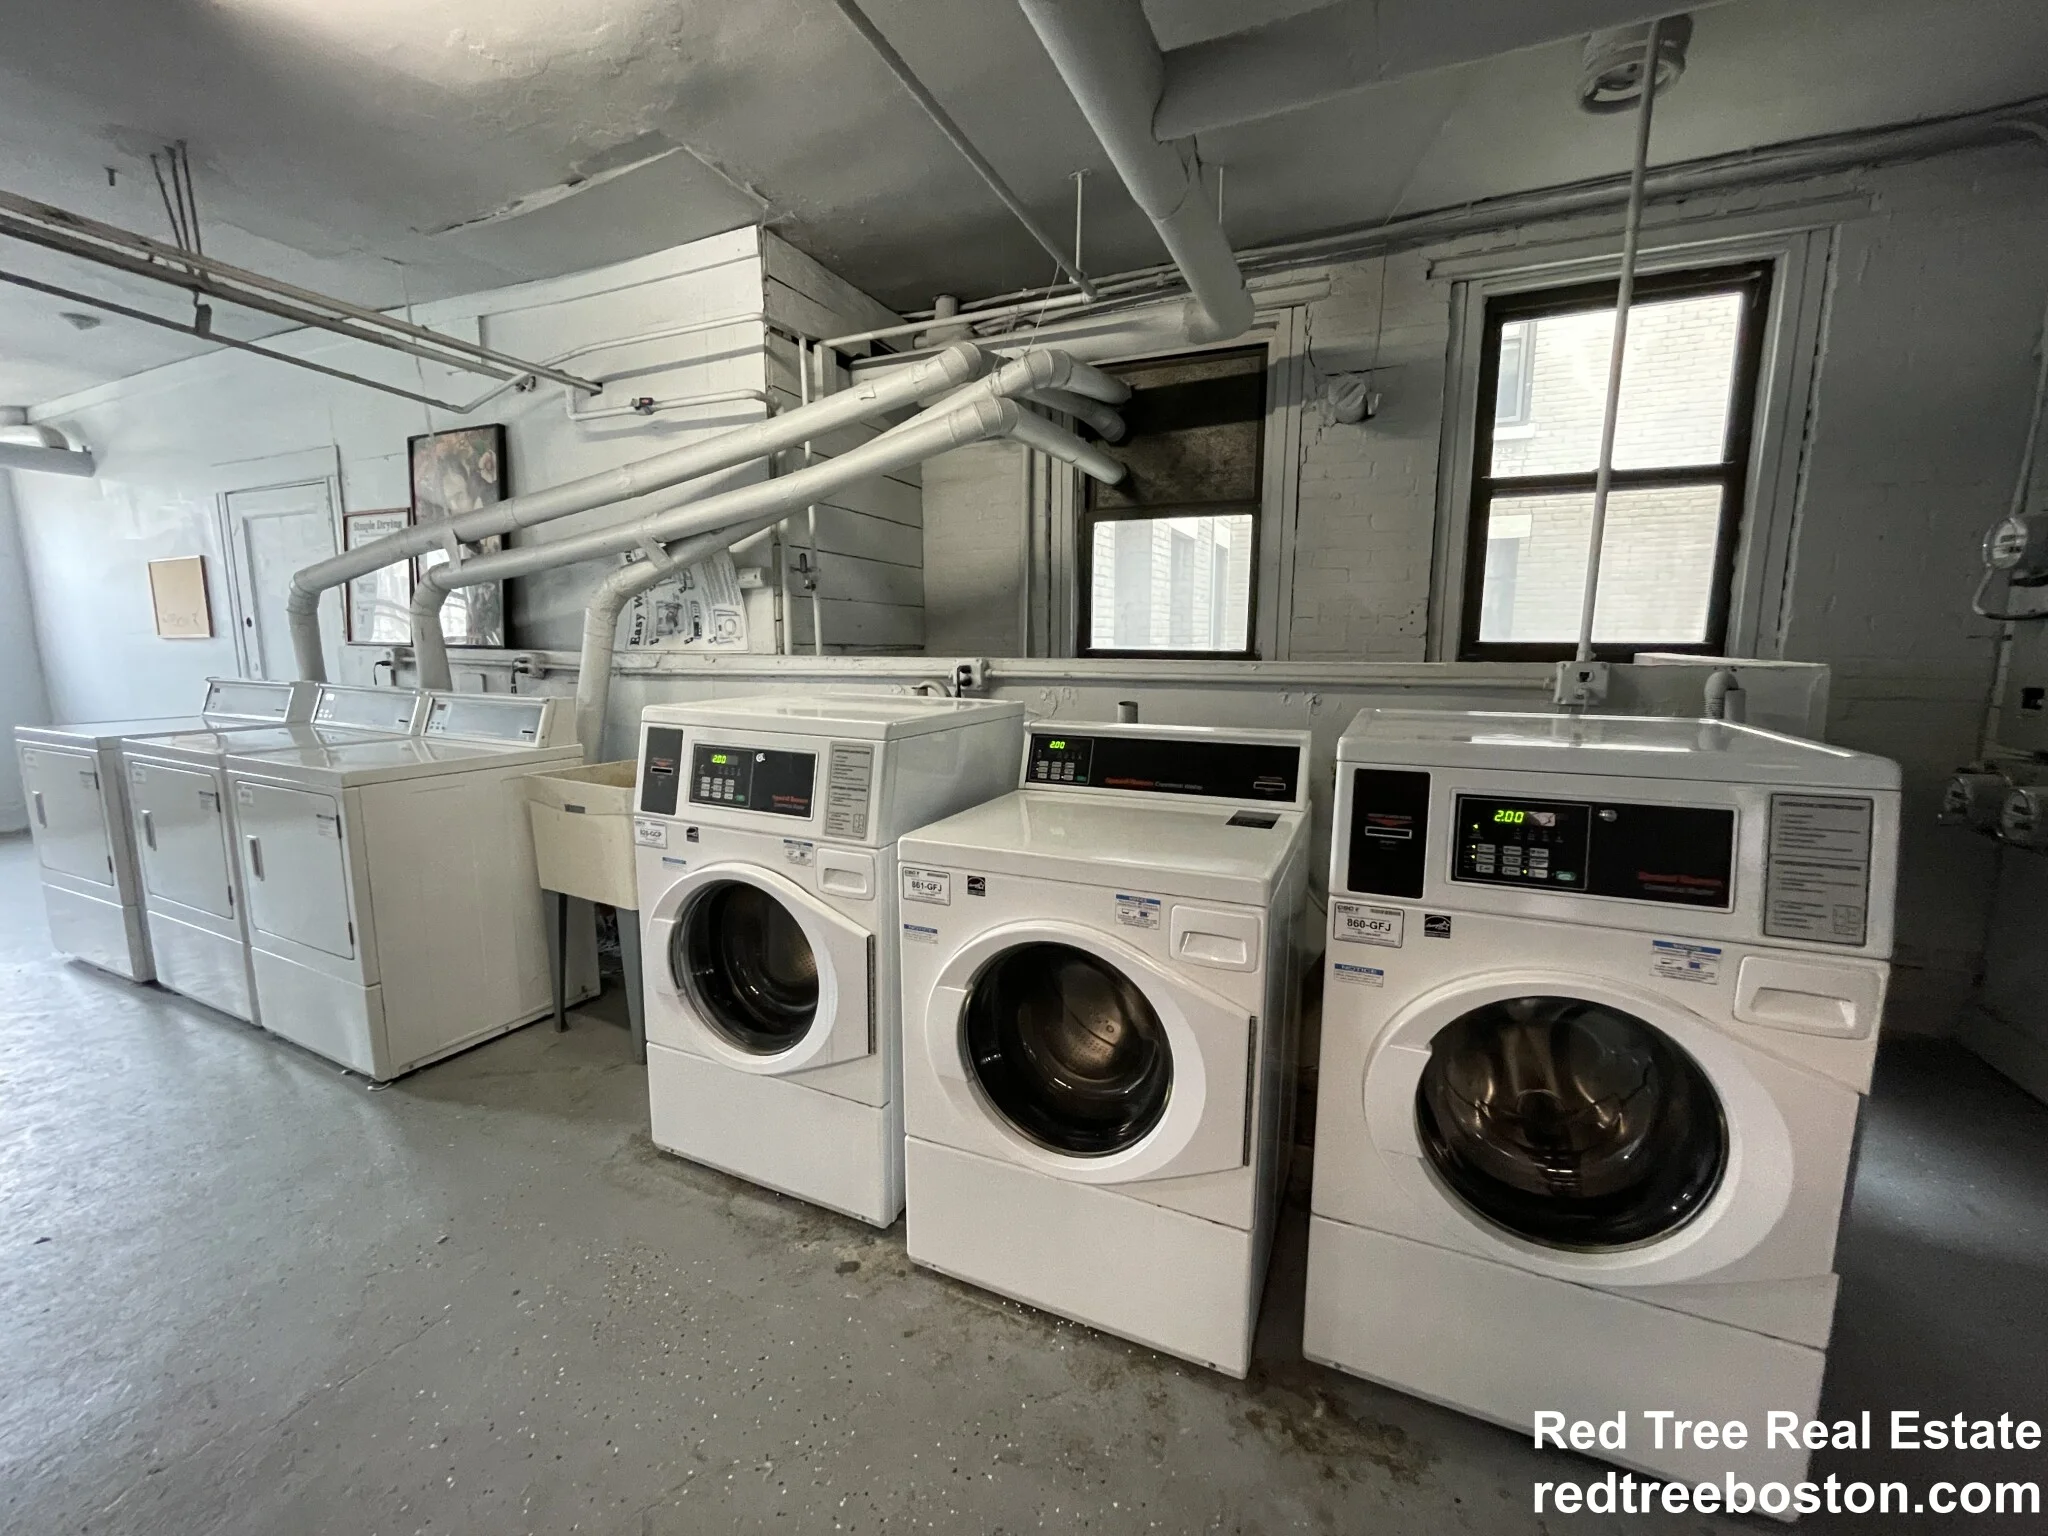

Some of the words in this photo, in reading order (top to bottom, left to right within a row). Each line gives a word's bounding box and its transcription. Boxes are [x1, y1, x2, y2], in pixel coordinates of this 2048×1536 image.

[376, 519, 402, 532] Drying
[629, 613, 646, 646] Easy
[1493, 809, 1525, 823] 2.00
[911, 880, 942, 892] 861-GFJ
[1346, 918, 1392, 932] 860-GFJ
